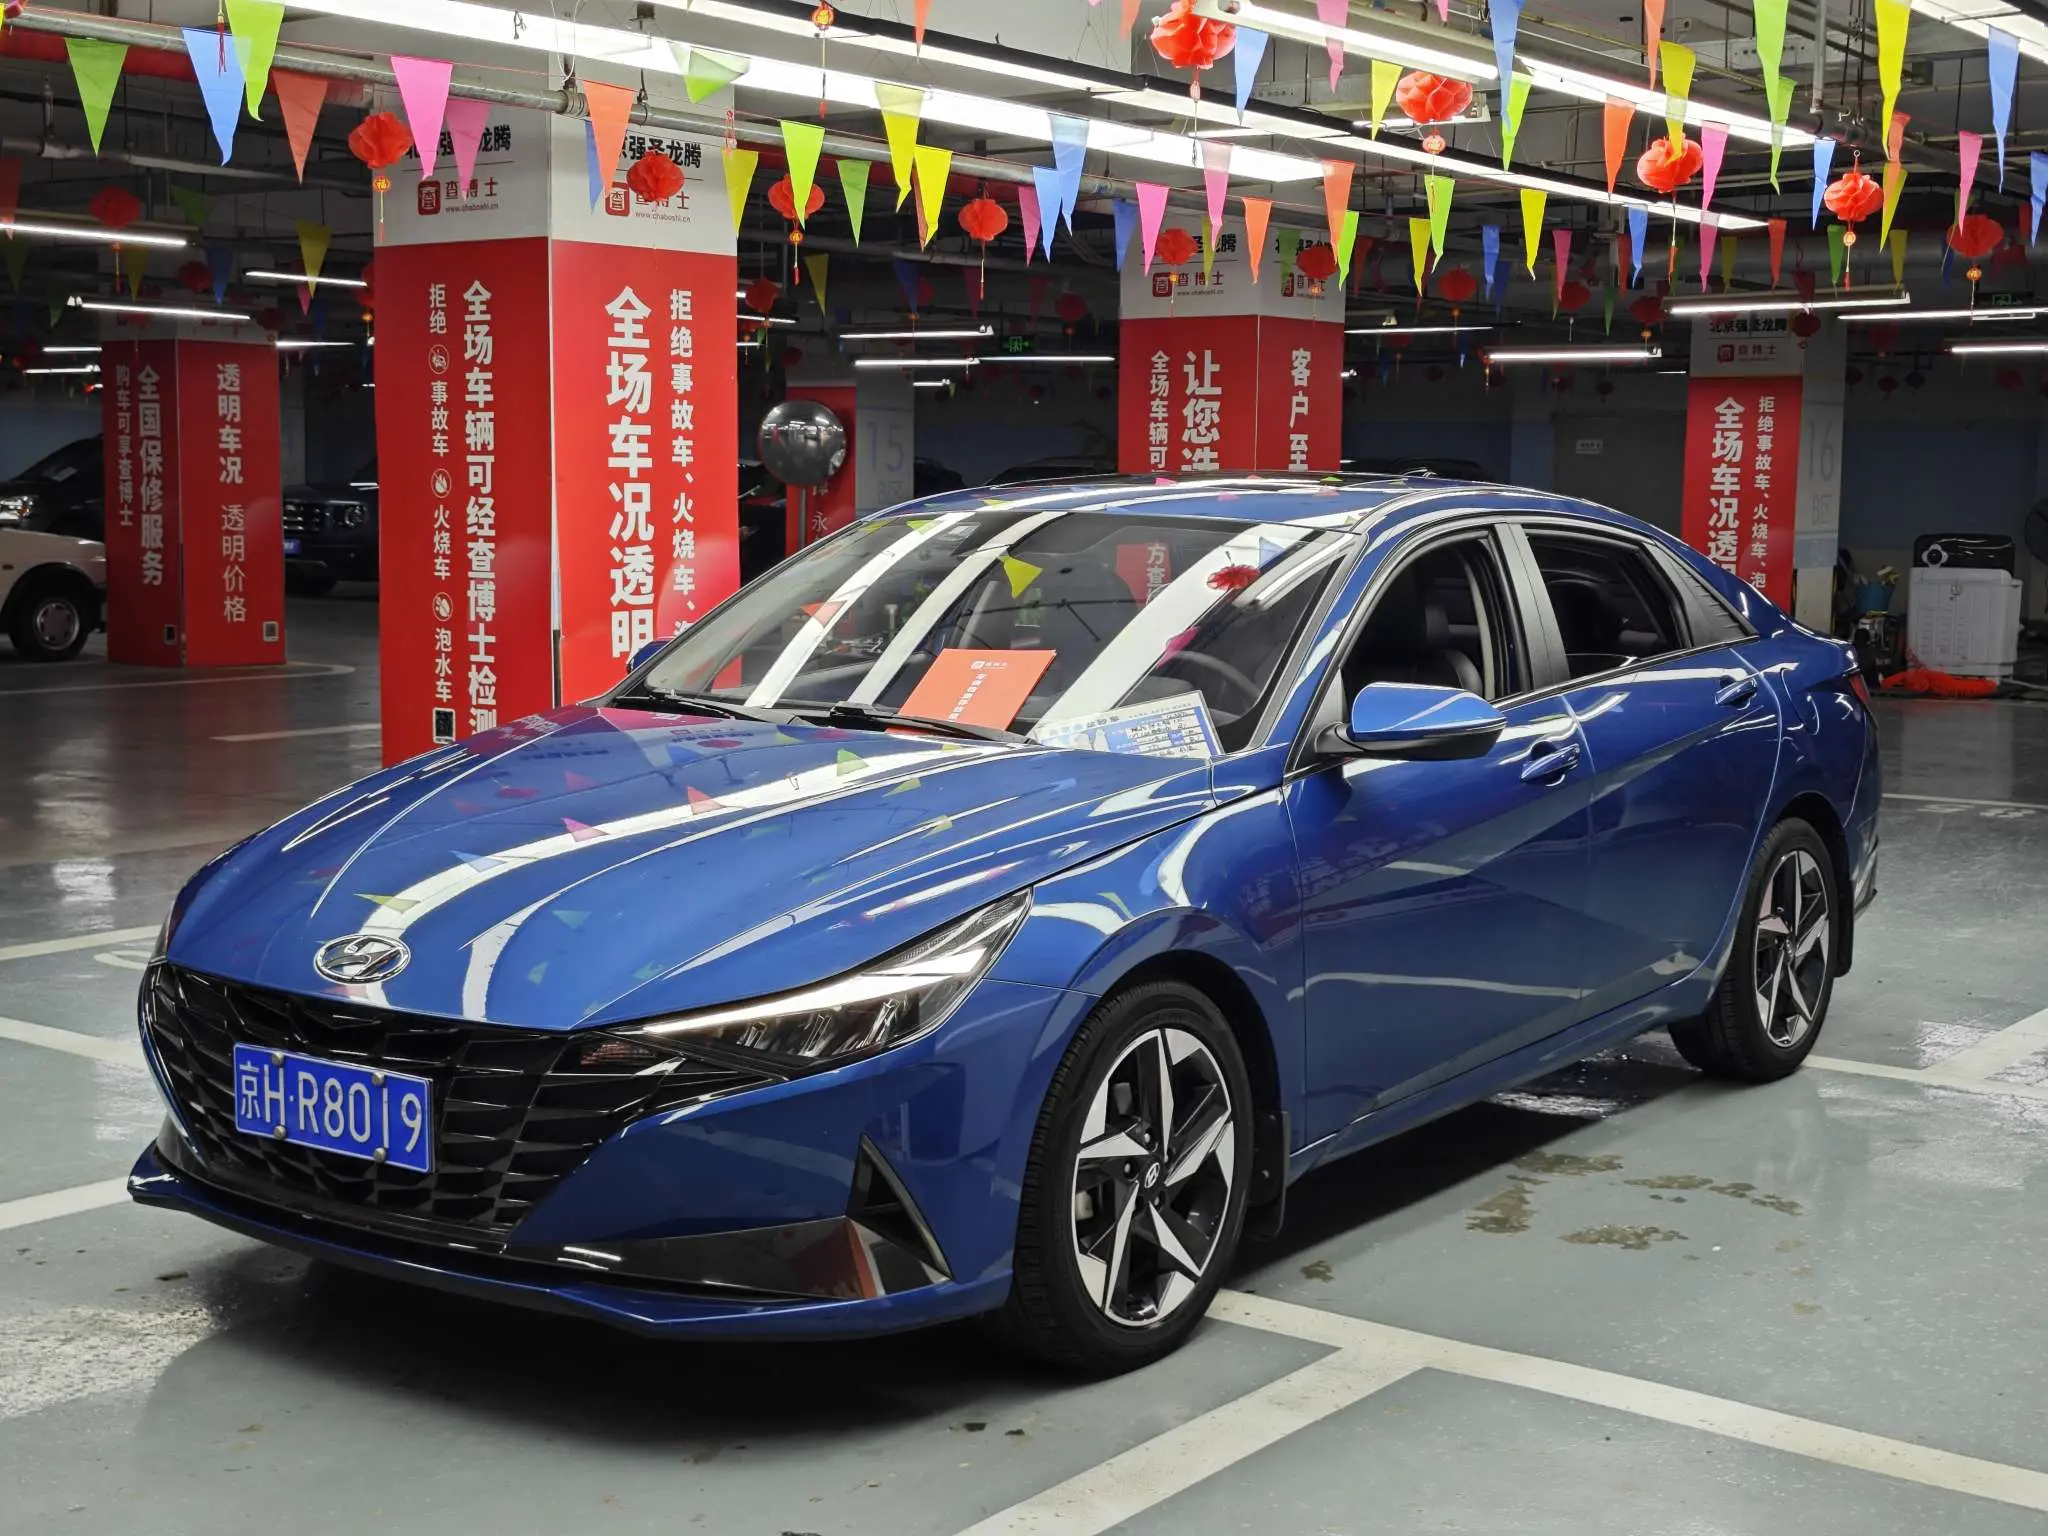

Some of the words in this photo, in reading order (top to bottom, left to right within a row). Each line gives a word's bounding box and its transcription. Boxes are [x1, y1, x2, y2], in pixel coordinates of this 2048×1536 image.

[429, 284, 447, 334] 拒绝
[116, 364, 133, 526] 购车可享查博士
[217, 363, 244, 484] 透明车况
[431, 380, 449, 457] 事故车
[1149, 350, 1169, 472] 全场车辆可
[1289, 348, 1311, 472] 客户至
[138, 365, 163, 586] 全国保修服务
[463, 280, 497, 735] 全场车辆可经查博士检测
[605, 286, 655, 658] 全场车况透明
[222, 504, 247, 623] 透明价格
[433, 505, 451, 580] 火烧车
[435, 628, 452, 703] 泡水车
